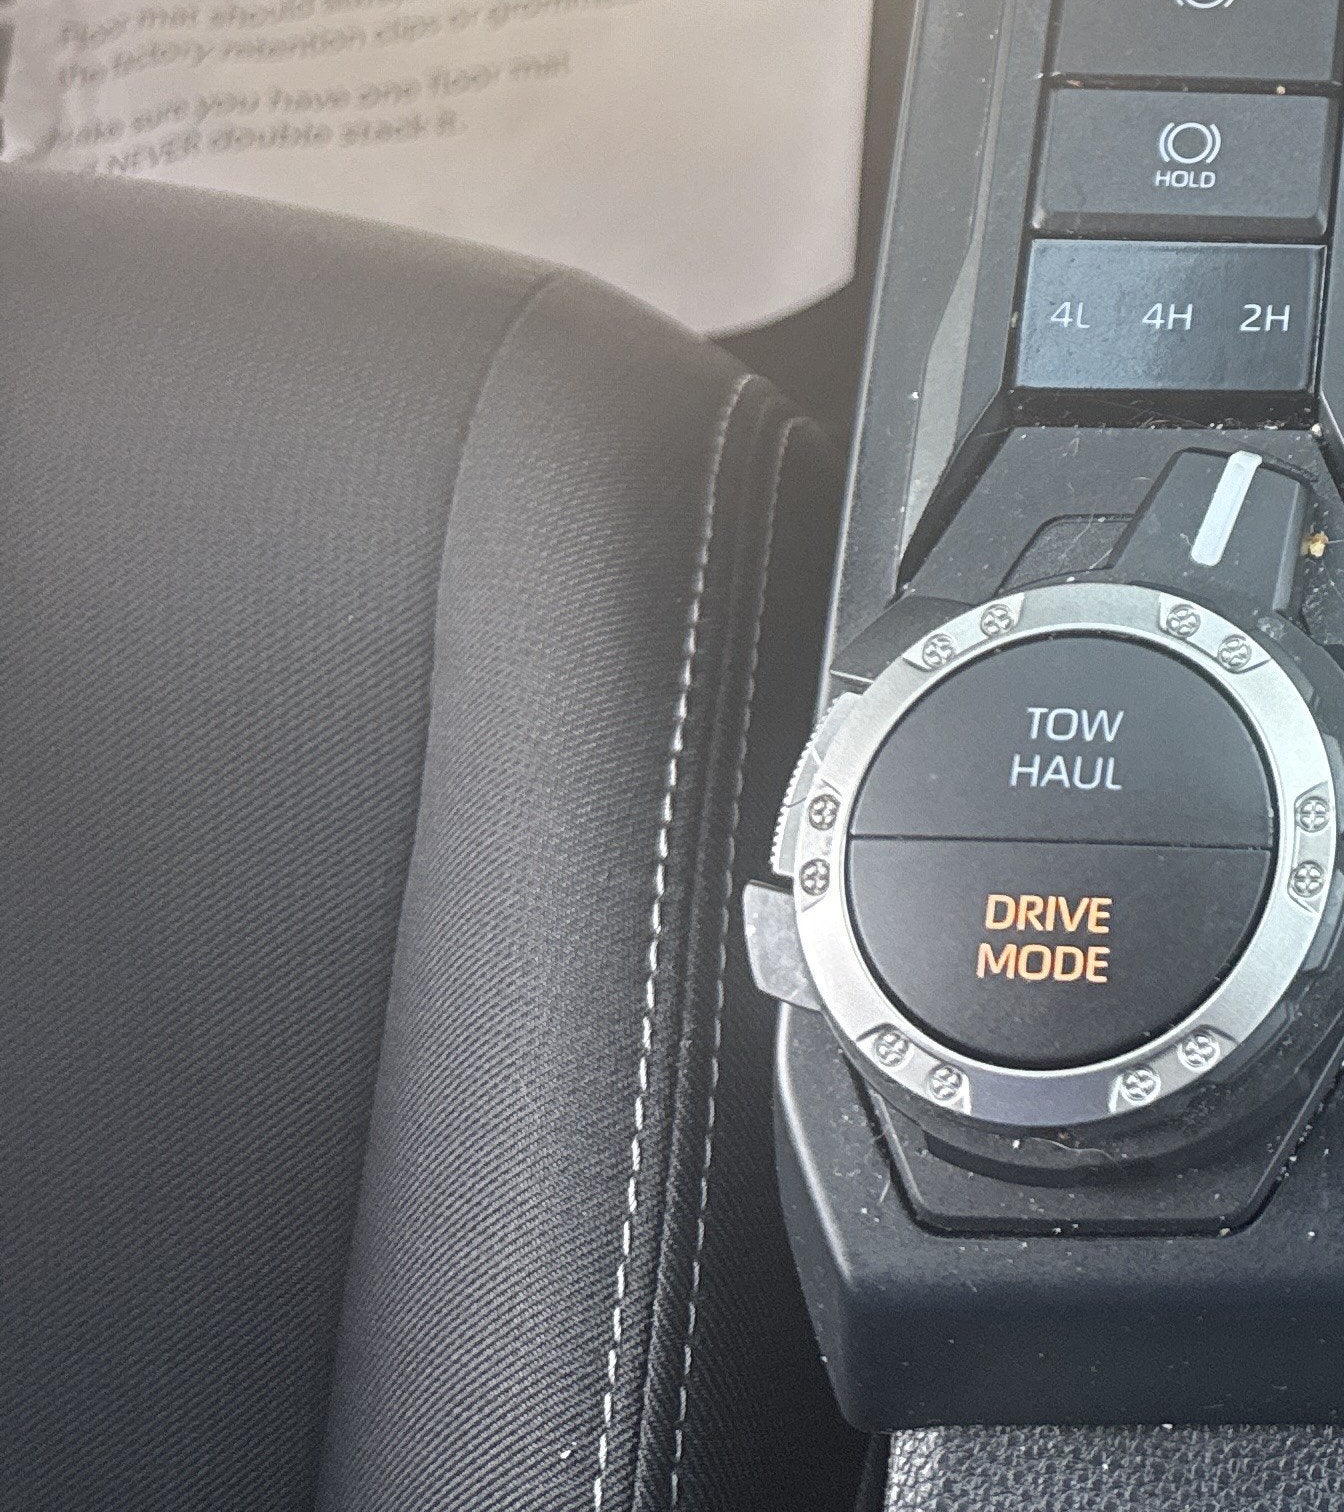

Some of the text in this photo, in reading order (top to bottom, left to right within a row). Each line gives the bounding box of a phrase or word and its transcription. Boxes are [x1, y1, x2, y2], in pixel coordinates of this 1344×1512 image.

[1154, 170, 1216, 189] HOLD
[1050, 301, 1291, 333] 4L 4H 2H
[1026, 707, 1124, 743] TOW
[1009, 754, 1123, 791] HAUL
[984, 892, 1113, 935] DRIVE
[975, 942, 1109, 984] MODE
